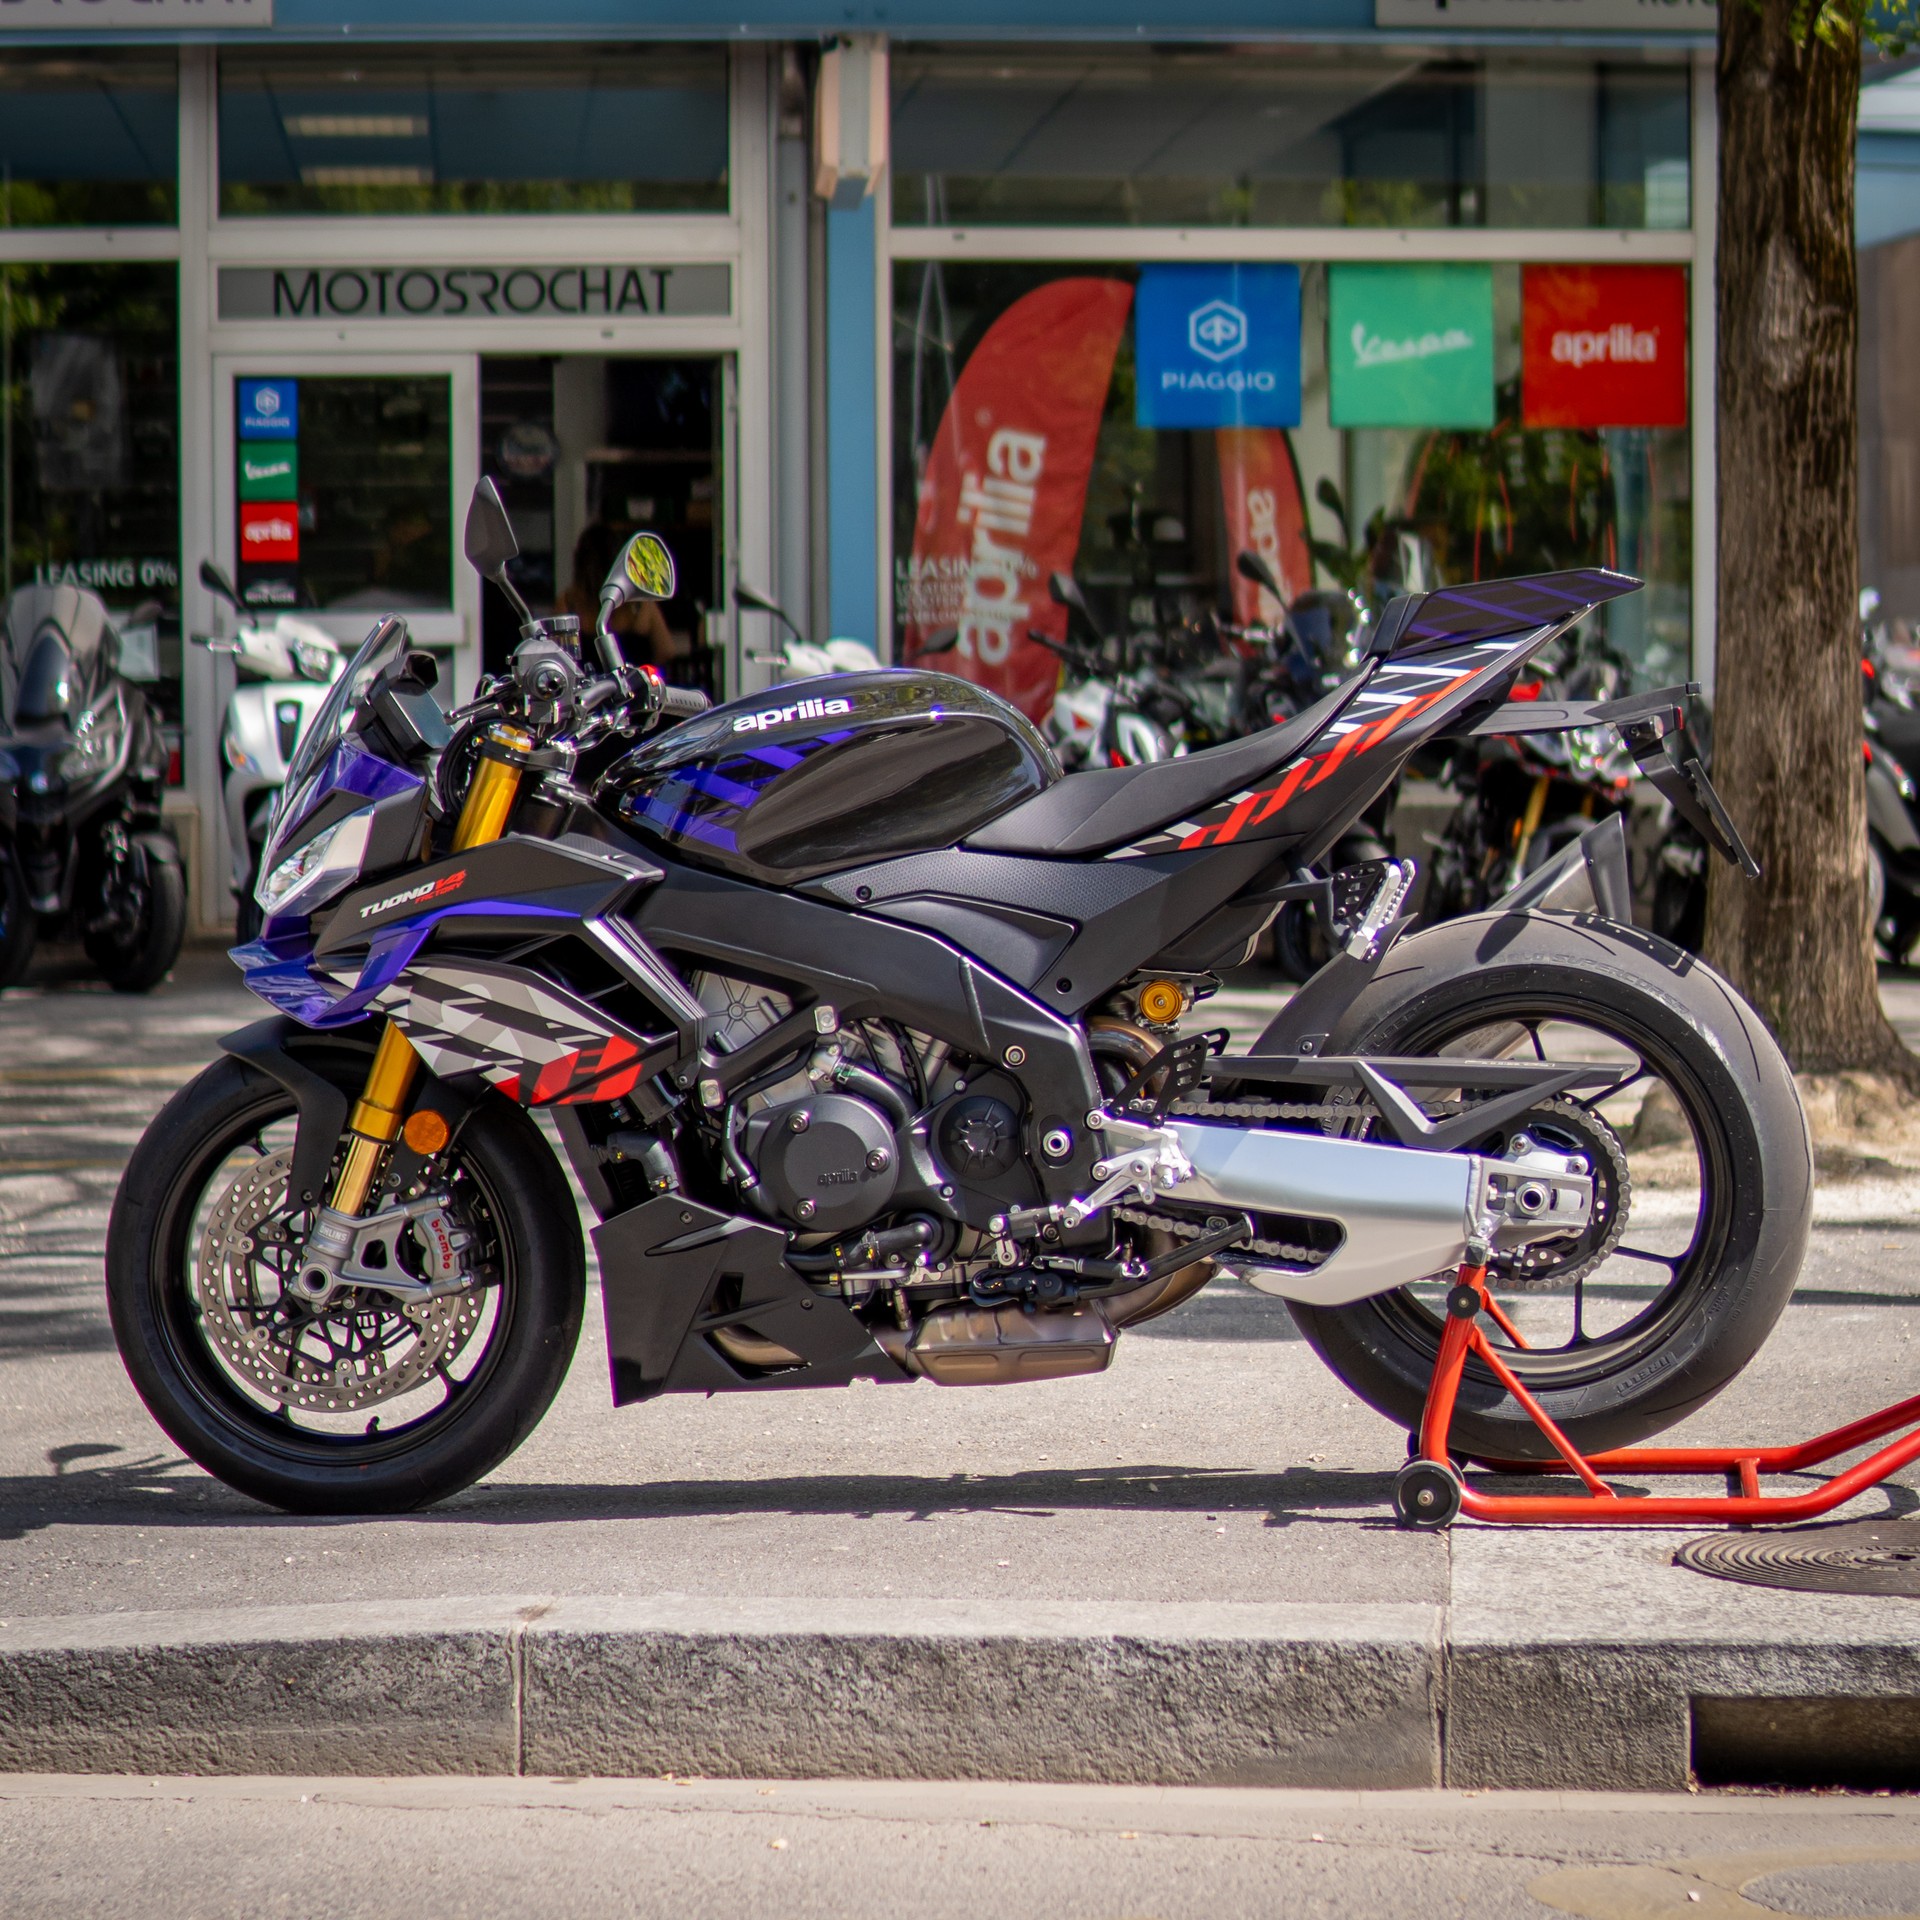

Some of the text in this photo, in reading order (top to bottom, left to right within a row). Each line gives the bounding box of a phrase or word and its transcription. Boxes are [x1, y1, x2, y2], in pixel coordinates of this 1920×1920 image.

[1551, 323, 1657, 368] aprilia
[1161, 370, 1276, 391] PIAGGIO
[957, 426, 1046, 667] aprilia
[35, 558, 178, 587] LEASING 0%
[732, 698, 852, 732] aprilia
[359, 881, 436, 919] TUONO
[431, 1218, 453, 1270] brembo
